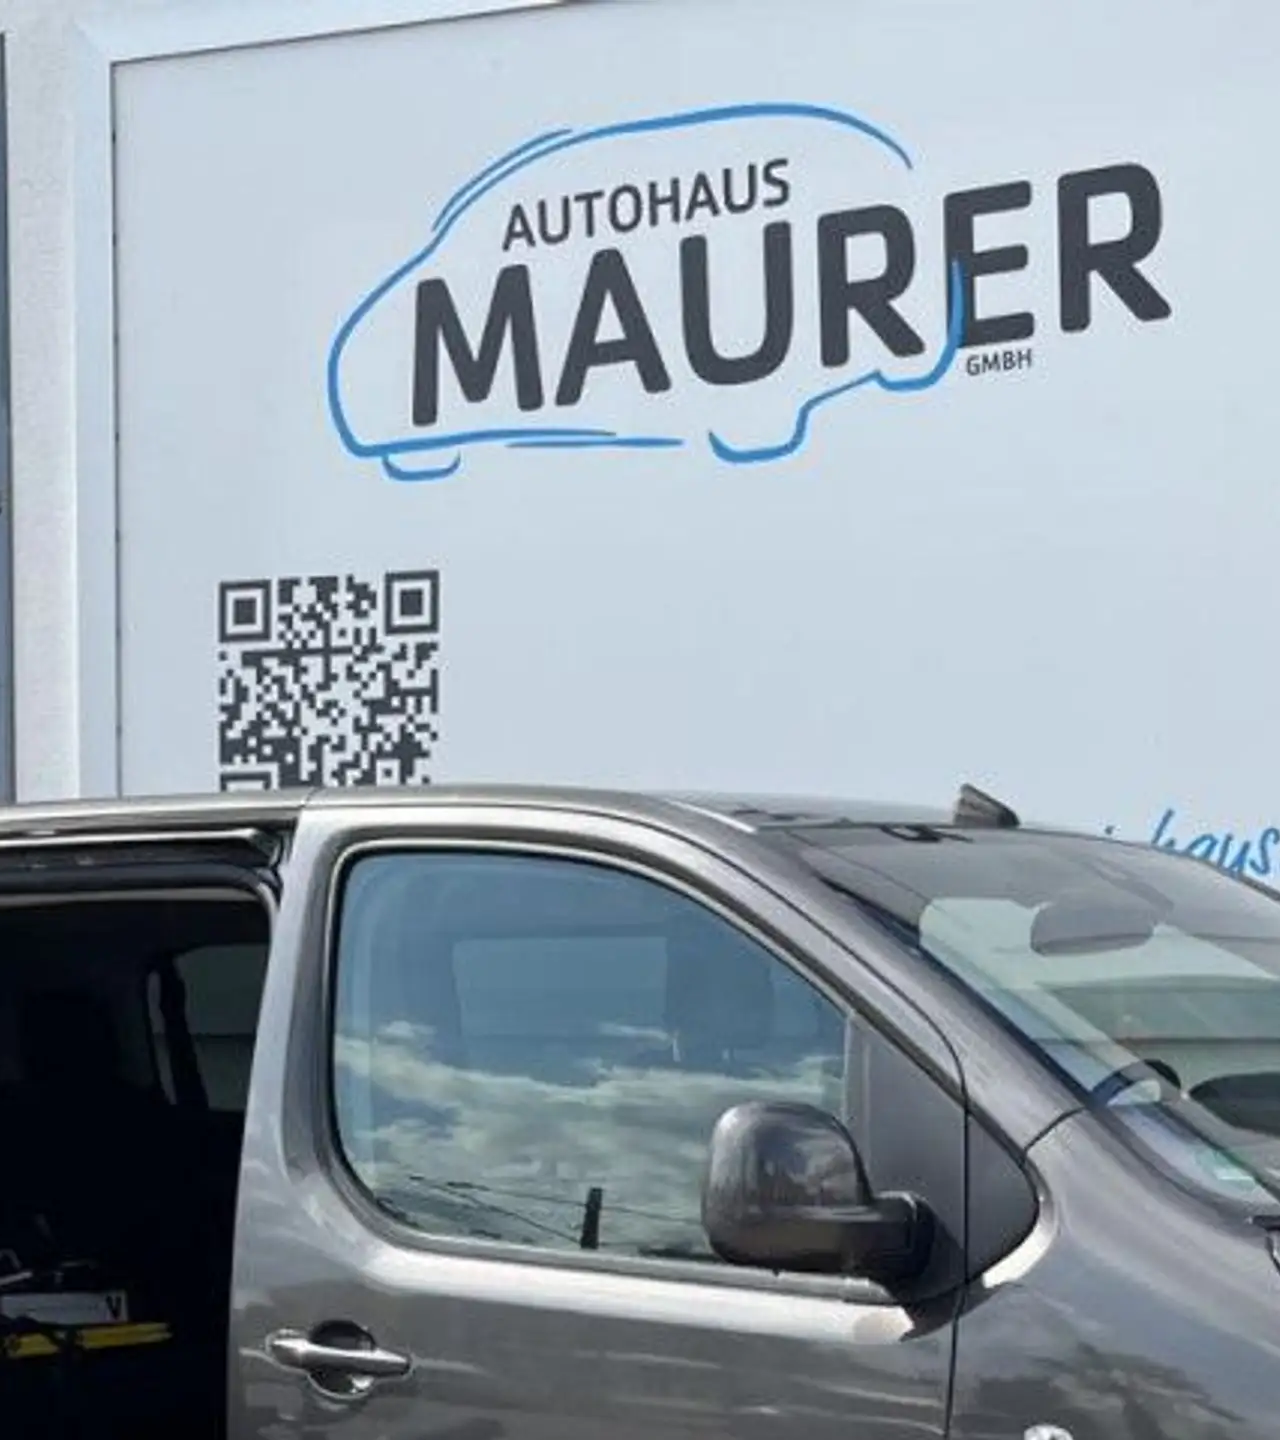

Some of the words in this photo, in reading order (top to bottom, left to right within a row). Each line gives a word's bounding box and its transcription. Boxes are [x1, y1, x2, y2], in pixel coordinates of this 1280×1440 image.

[502, 158, 789, 251] AUTOHAUS
[412, 163, 1172, 427] MAURER
[966, 347, 1033, 376] GMBH
